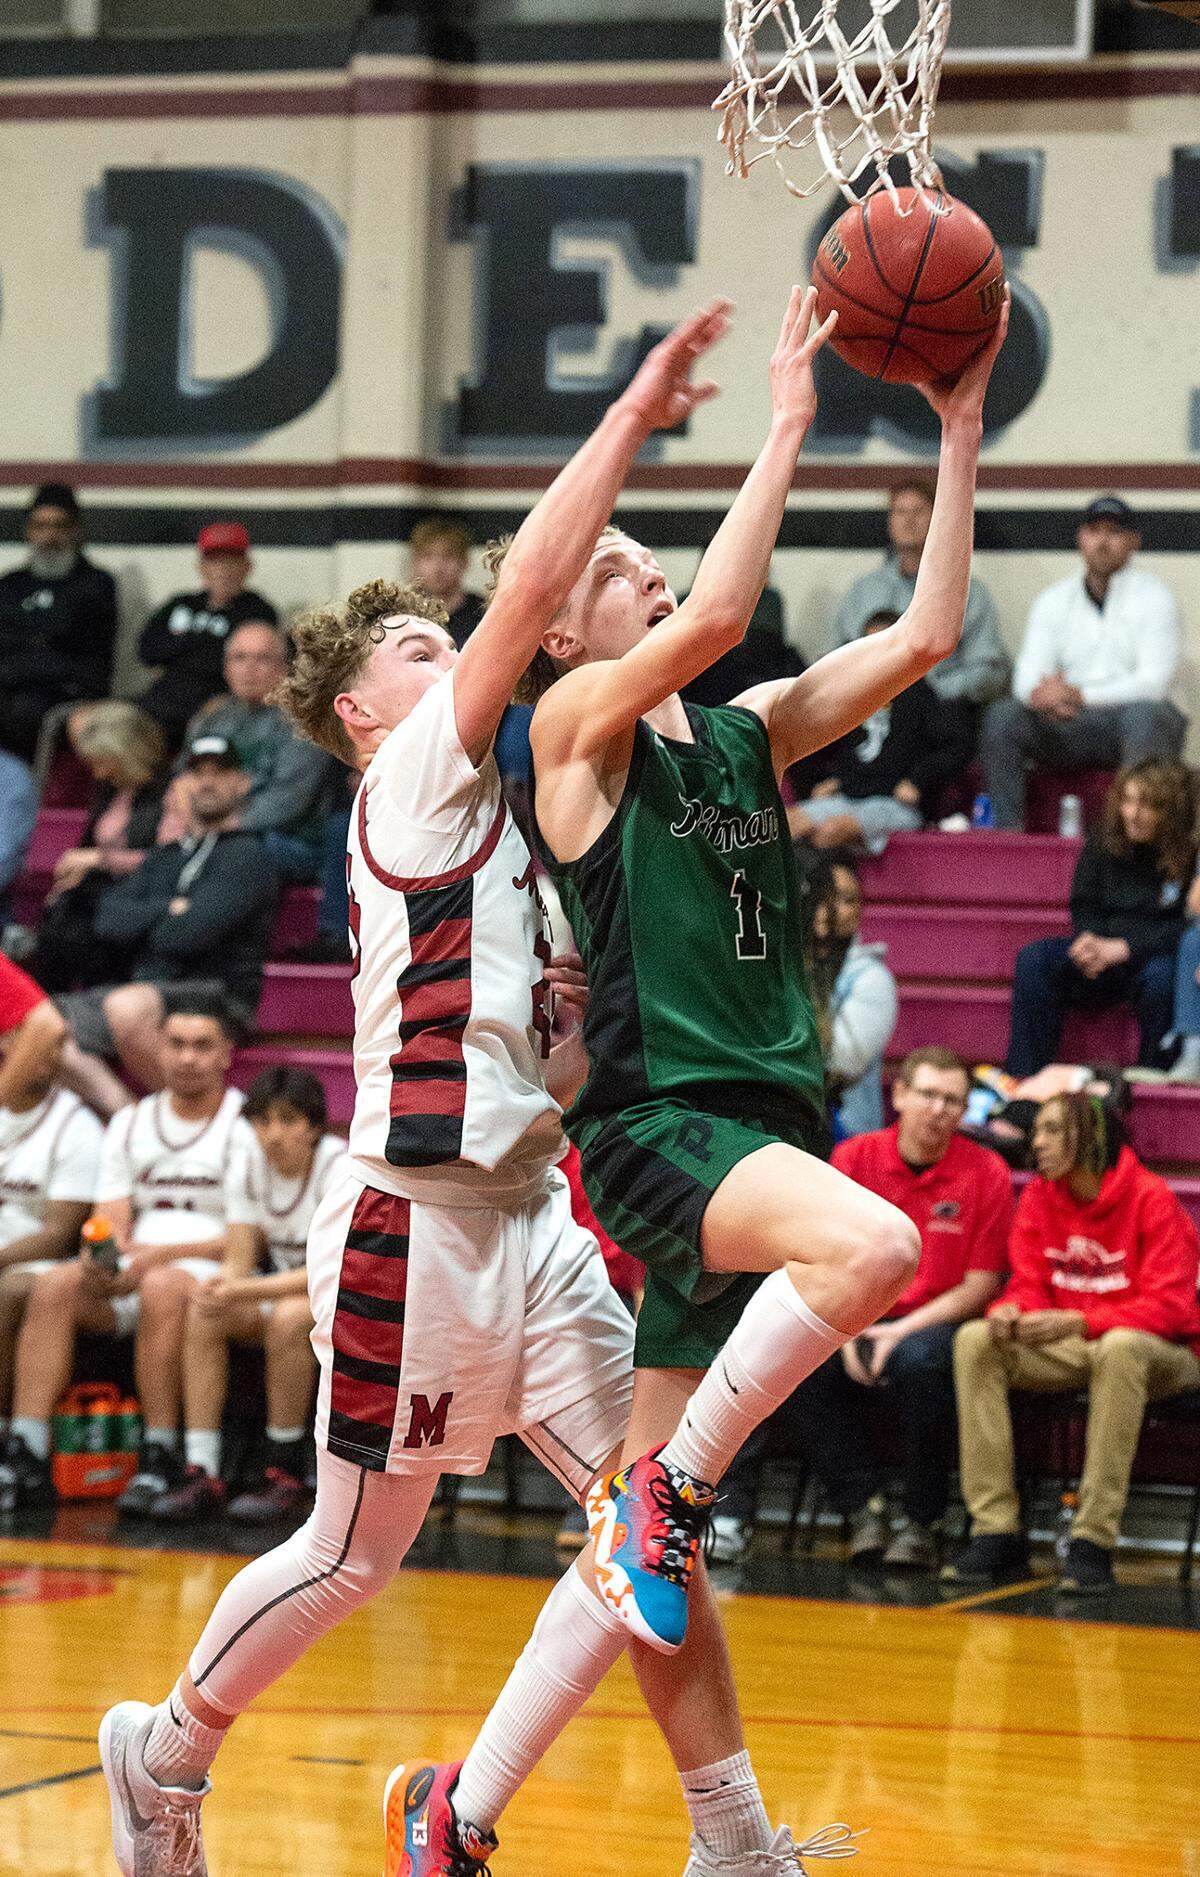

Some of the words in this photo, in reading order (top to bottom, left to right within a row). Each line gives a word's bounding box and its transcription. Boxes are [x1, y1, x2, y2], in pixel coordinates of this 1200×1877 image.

[0, 143, 1200, 460] DES
[729, 868, 767, 960] 1
[673, 1117, 714, 1164] P
[403, 1391, 454, 1449] M
